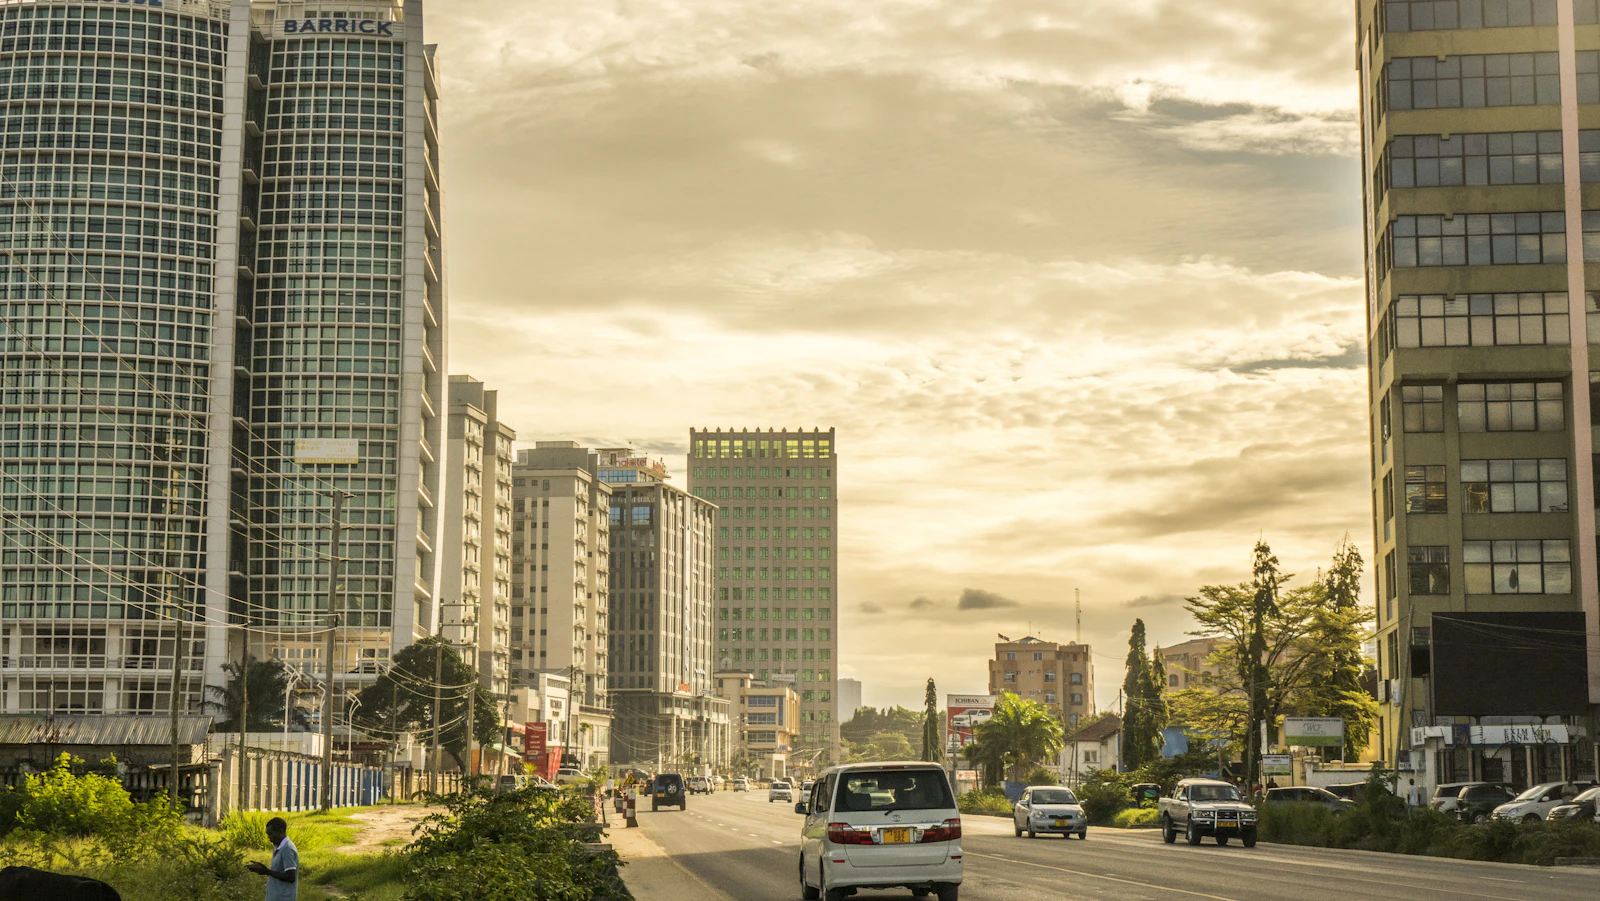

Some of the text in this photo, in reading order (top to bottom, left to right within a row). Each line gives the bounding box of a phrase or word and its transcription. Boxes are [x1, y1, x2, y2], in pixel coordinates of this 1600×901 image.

[284, 19, 393, 36] BARRICK
[614, 457, 647, 468] halotel
[1504, 728, 1528, 736] EXIM
